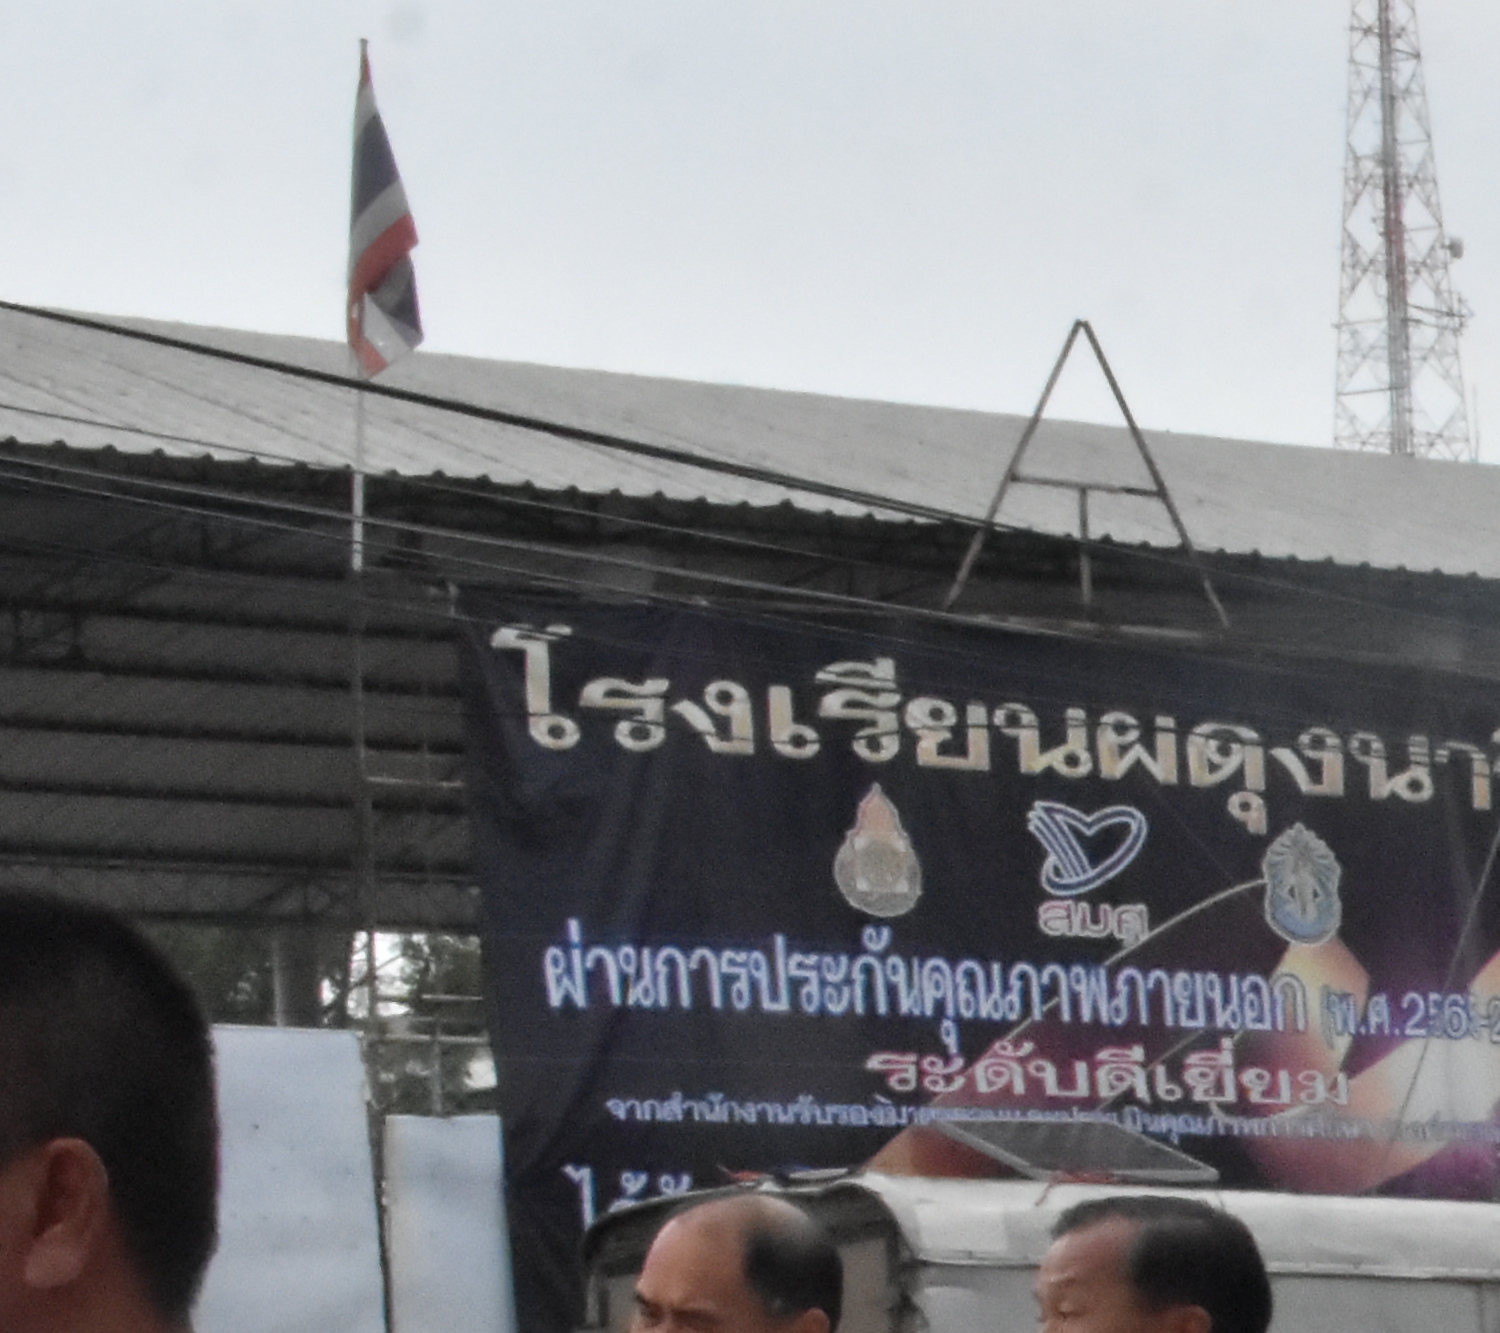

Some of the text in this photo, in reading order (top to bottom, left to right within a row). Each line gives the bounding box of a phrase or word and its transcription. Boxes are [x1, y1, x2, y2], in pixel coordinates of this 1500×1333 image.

[543, 916, 1310, 1056] ผ่านการประกันคุณภาพภายนอก
[865, 1036, 1348, 1105] ระดับดีเยี่ยม
